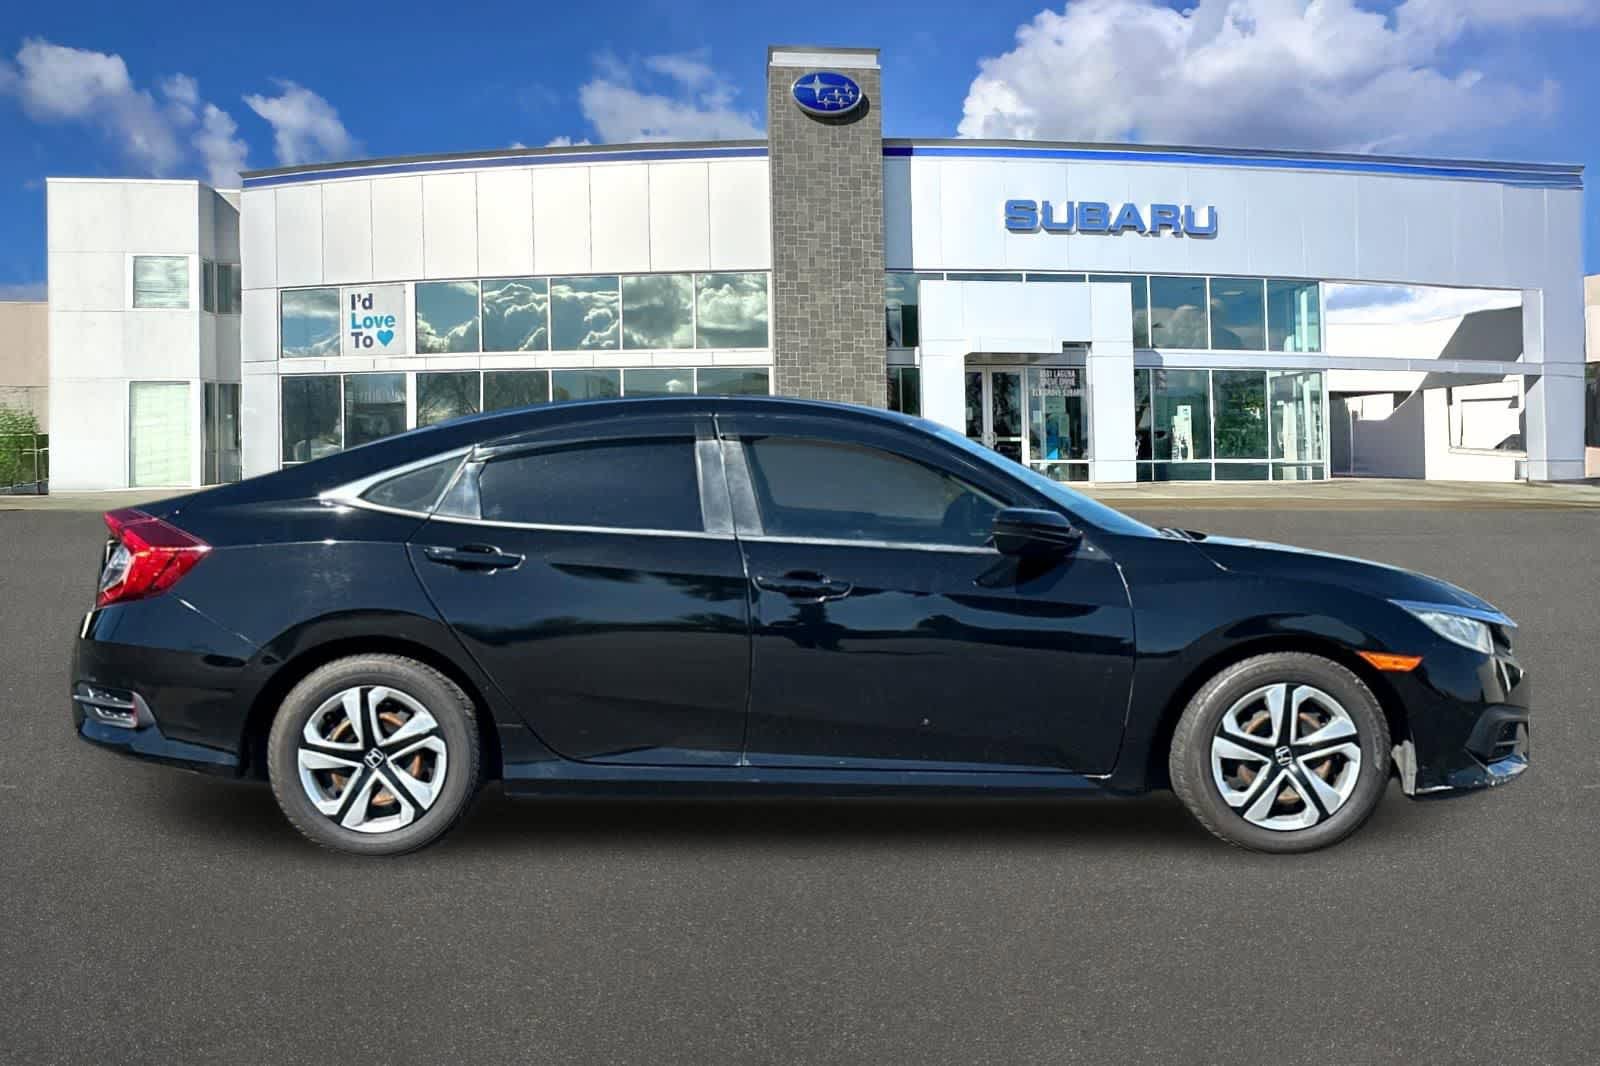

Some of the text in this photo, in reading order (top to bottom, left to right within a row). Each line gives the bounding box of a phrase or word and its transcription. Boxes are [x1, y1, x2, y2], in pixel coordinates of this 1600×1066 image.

[1005, 199, 1217, 239] SUBARU
[351, 312, 396, 329] Love
[351, 331, 374, 348] To
